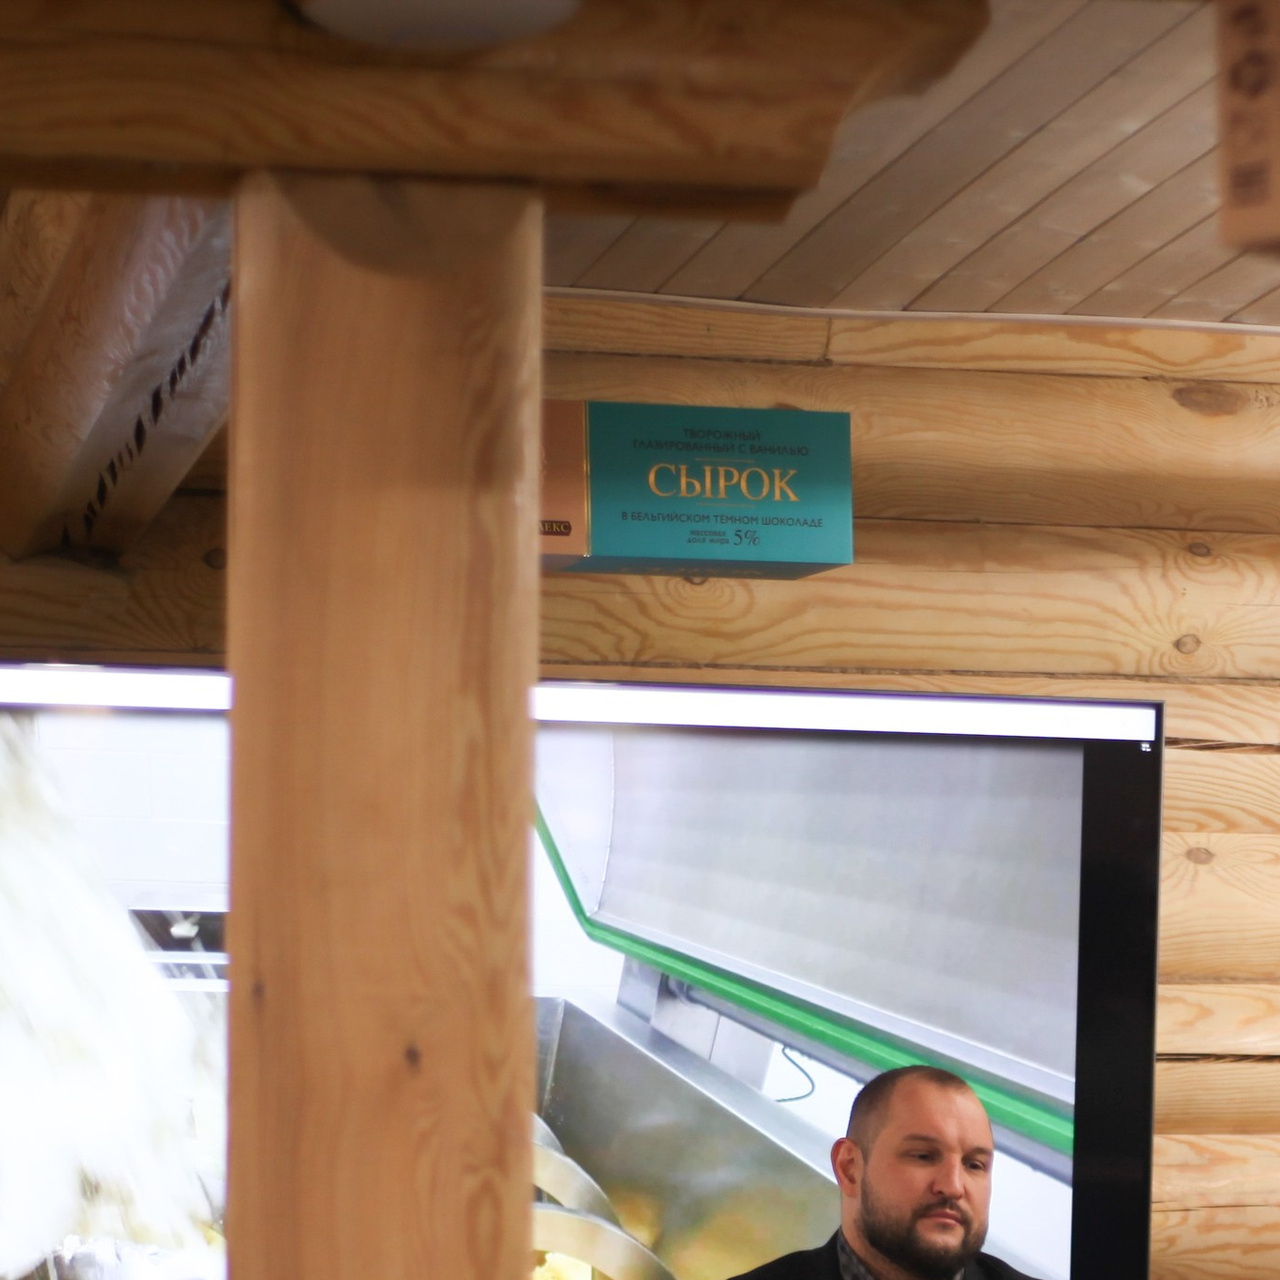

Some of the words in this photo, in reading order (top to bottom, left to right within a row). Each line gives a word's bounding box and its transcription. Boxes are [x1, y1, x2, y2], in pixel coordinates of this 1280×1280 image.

[683, 428, 761, 441] ТВОРОЖНЫЙ
[633, 439, 735, 453] ГЛАЗИРОВАННЫЙ
[739, 445, 747, 454] С
[751, 445, 809, 457] ВАНИЛЬЮ
[648, 462, 801, 502] СЫРОК
[621, 511, 628, 521] В
[631, 510, 711, 524] БЕЛЬГИЙСКОМ
[761, 516, 824, 528] ШОКОЛАДЕ
[733, 529, 760, 546] 5%
